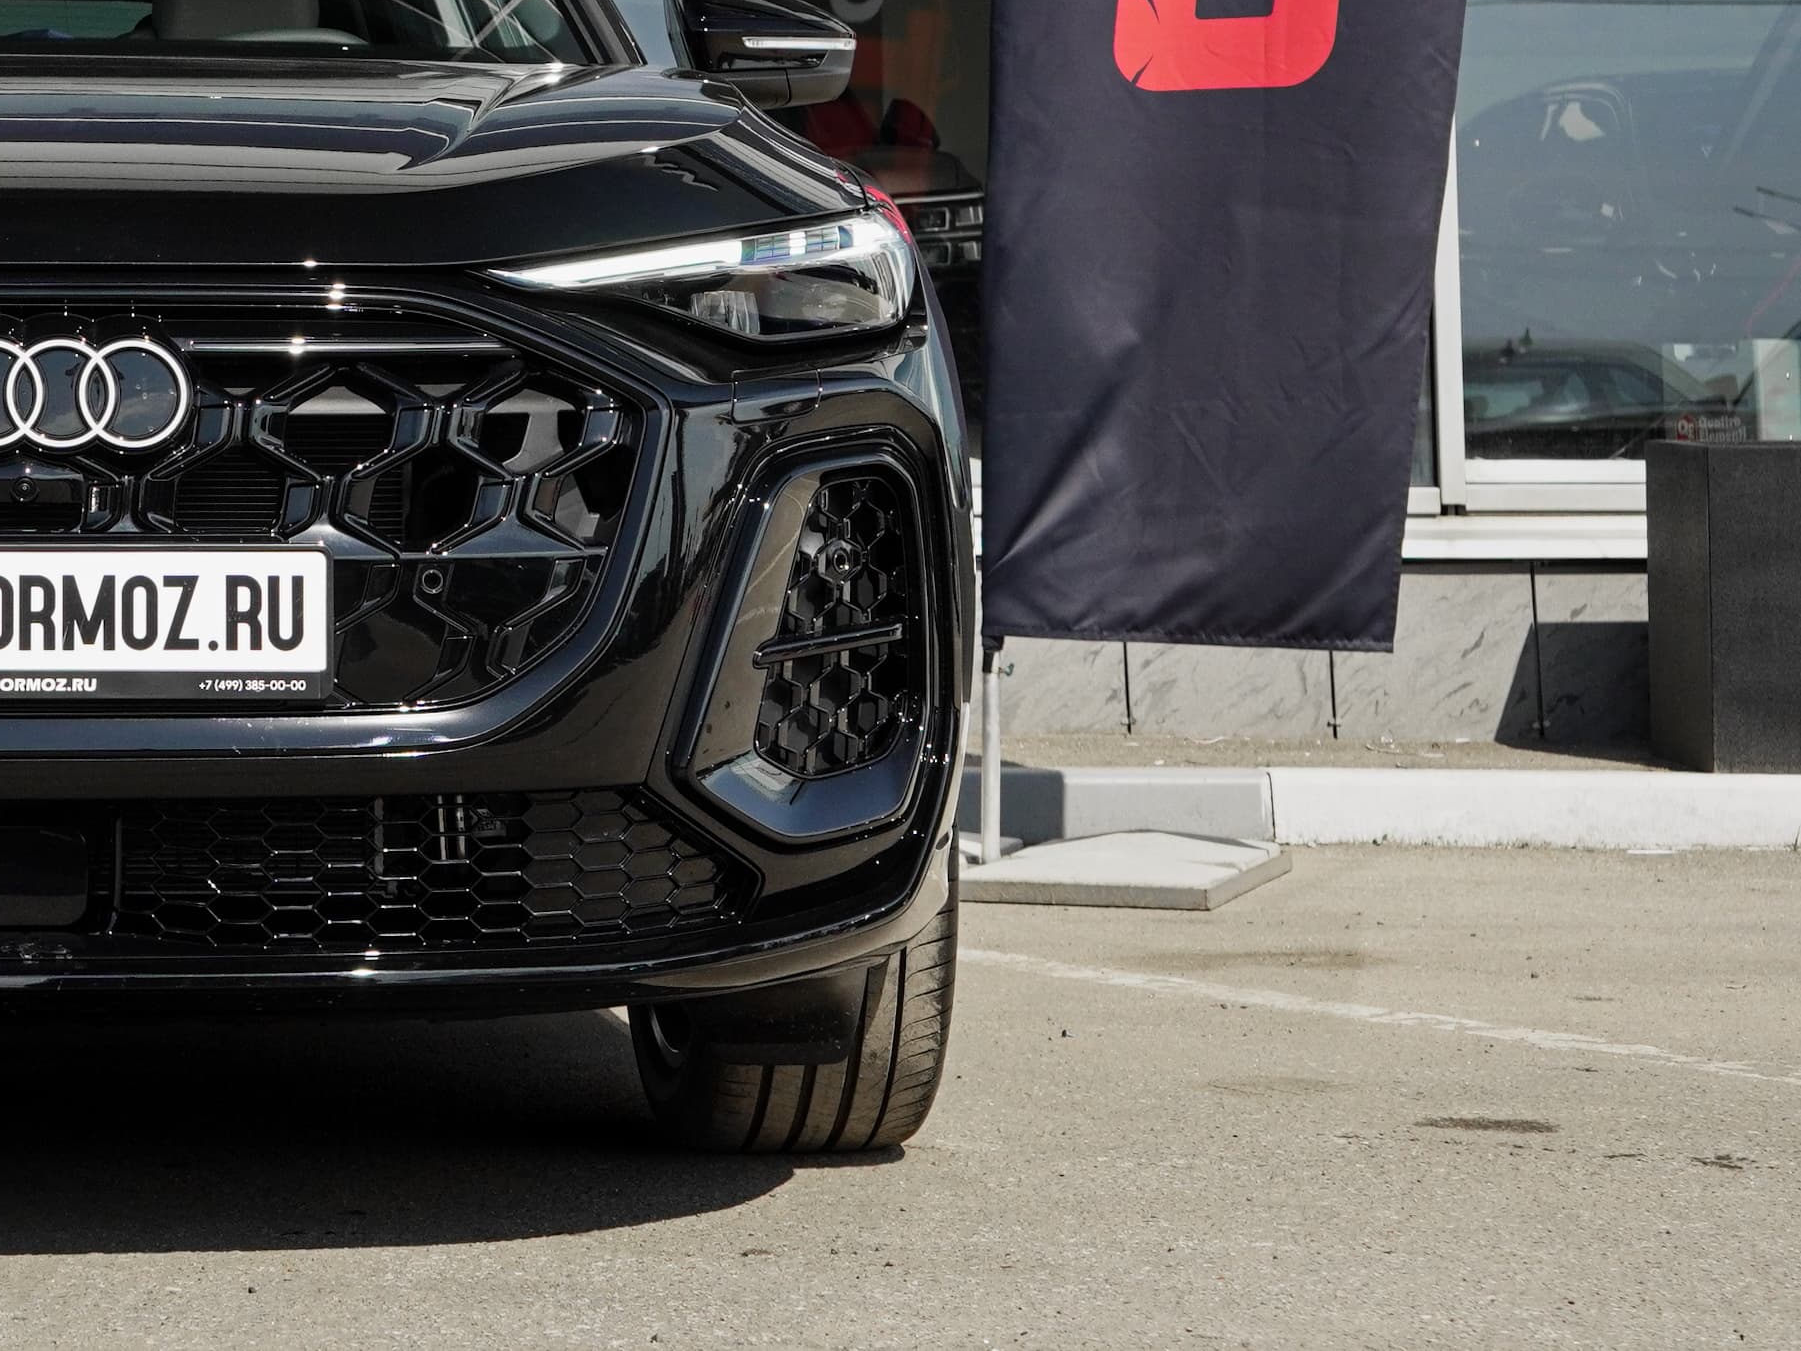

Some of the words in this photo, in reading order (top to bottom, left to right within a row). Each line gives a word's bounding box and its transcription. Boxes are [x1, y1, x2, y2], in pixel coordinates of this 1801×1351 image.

[199, 680, 213, 690] +7
[214, 678, 243, 692] (499)
[244, 679, 307, 691] 385-00-00
